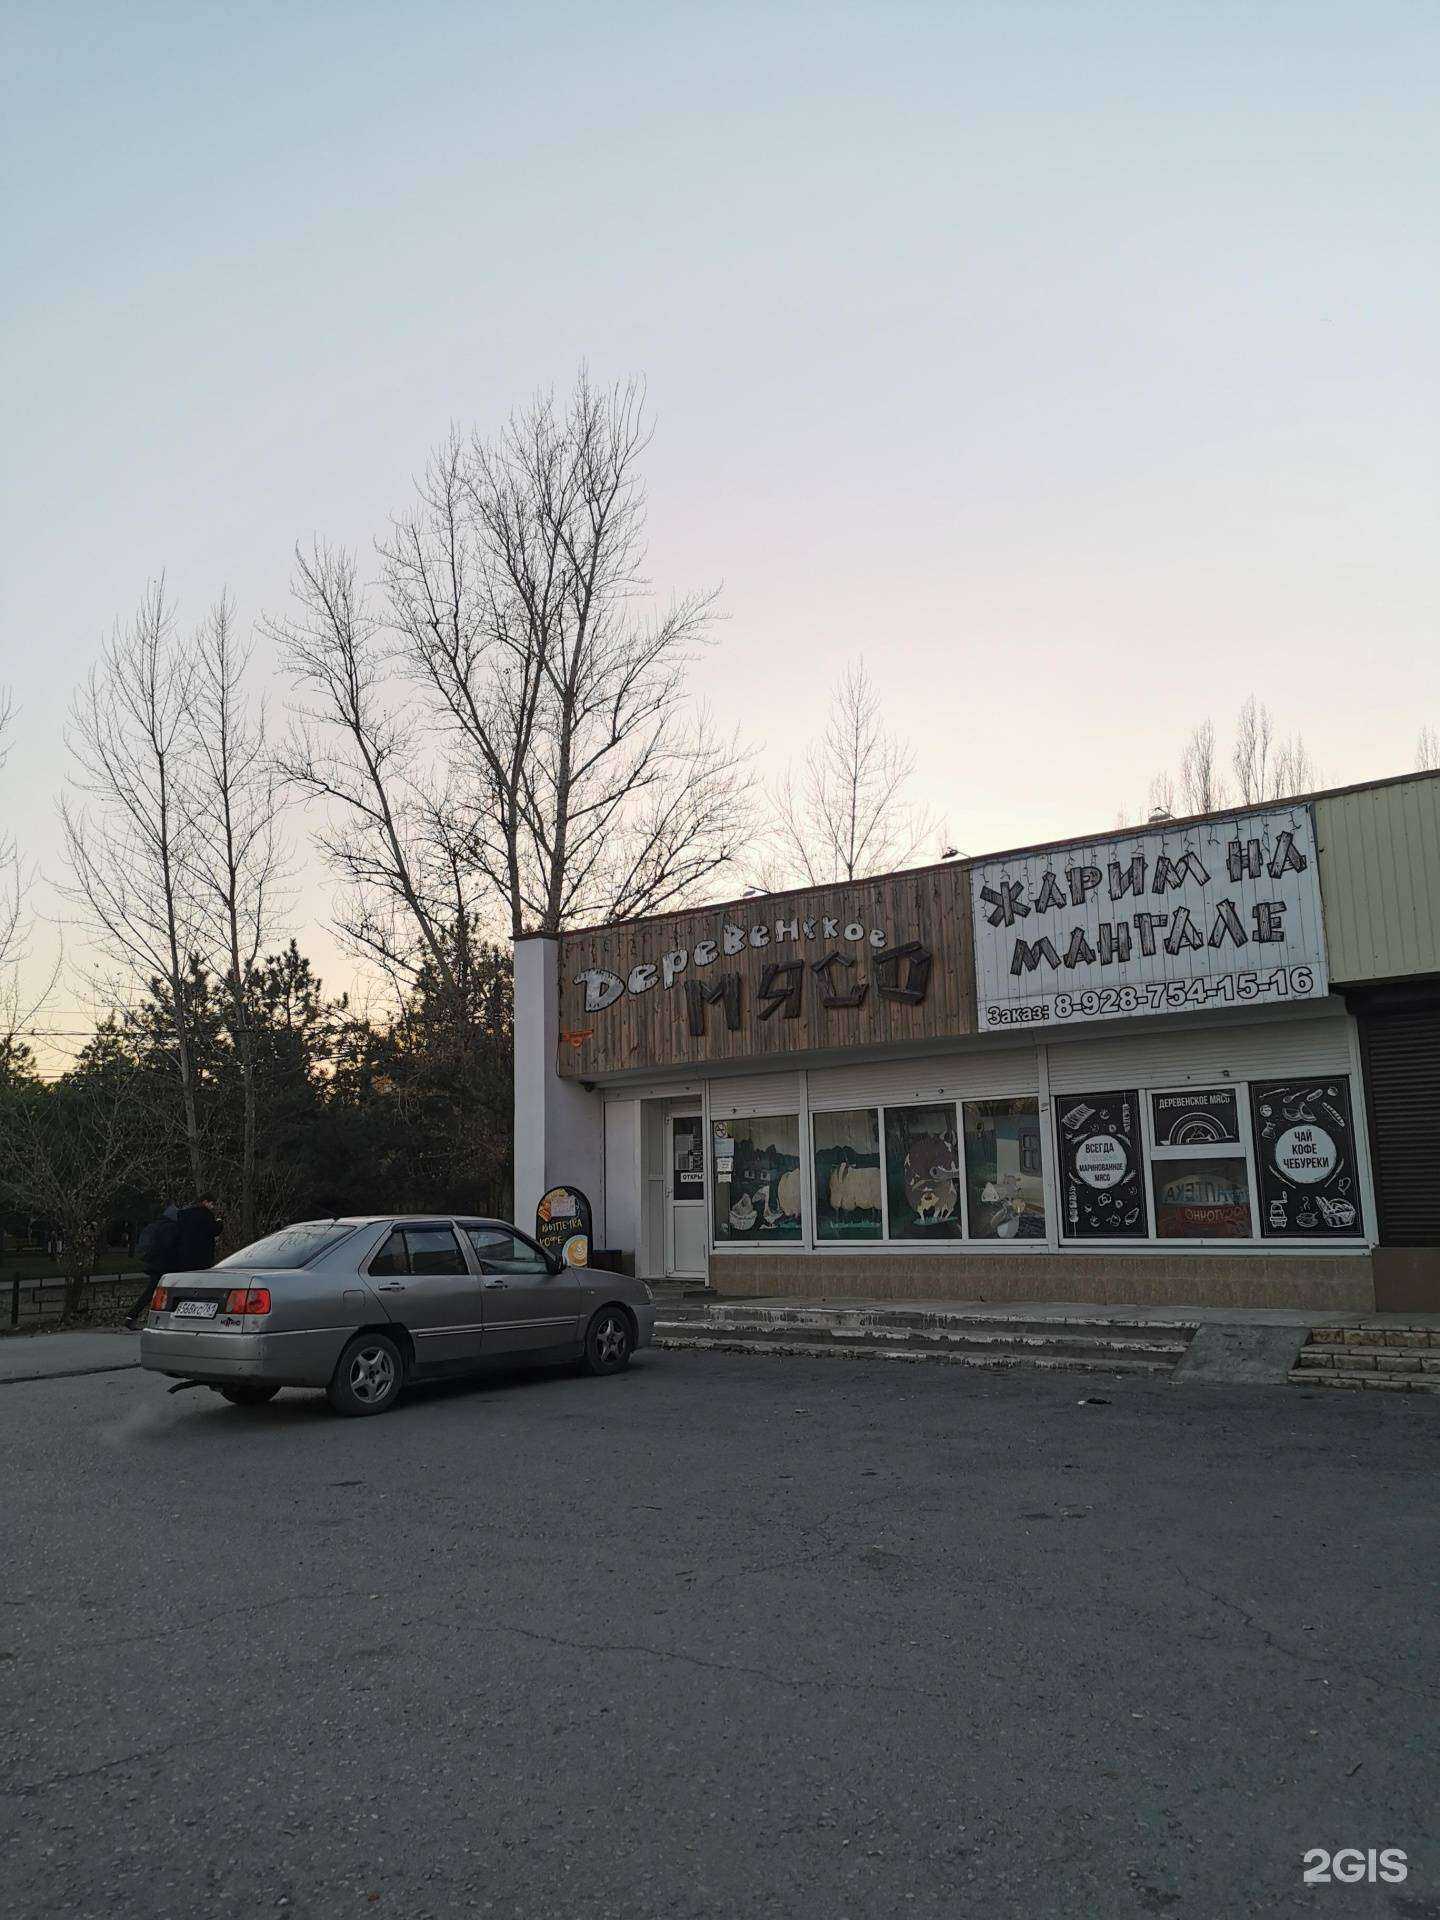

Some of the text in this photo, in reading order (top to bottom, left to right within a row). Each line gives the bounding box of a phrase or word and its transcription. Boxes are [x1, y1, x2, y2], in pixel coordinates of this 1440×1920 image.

[979, 831, 1307, 927] ЖАРИМ НА
[1010, 898, 1286, 976] МАНГАЛЕ
[685, 940, 932, 1036] МЯСО
[988, 966, 1314, 1026] Заказ: 8-928-754-15-16
[1158, 1095, 1208, 1109] ДЕРЕВЕНСКОЕ
[1294, 1130, 1313, 1143] ЧАЙ
[1085, 1142, 1115, 1154] ВСЕГДА
[1292, 1143, 1318, 1155] КОФЕ
[1079, 1162, 1124, 1172] МАРИНОВАННОЕ
[1283, 1156, 1329, 1169] ЧЕБУРЕКИ
